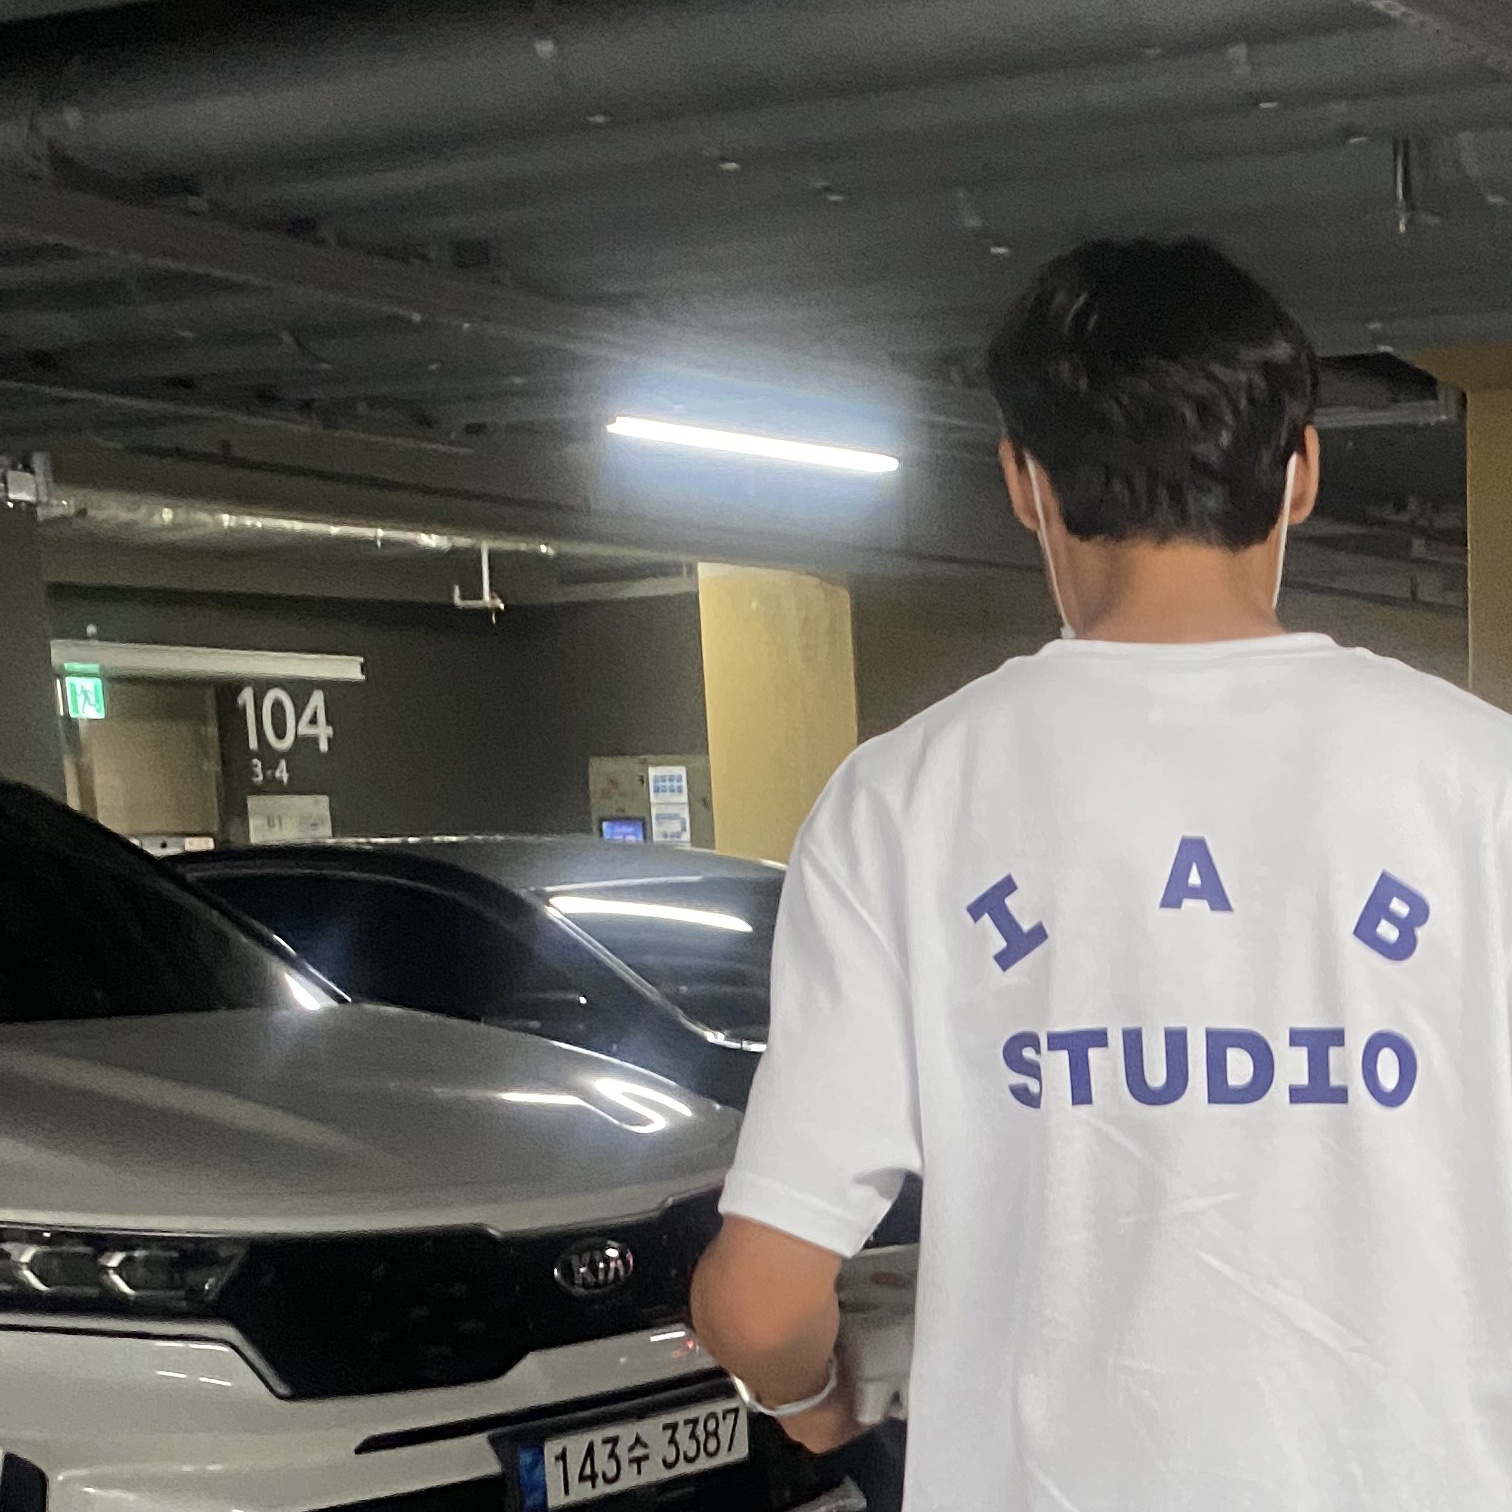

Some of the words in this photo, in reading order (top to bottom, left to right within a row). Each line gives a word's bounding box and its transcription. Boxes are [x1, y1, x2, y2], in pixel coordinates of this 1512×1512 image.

[236, 686, 334, 753] 104
[1002, 1026, 1418, 1108] STUDIO
[569, 1249, 628, 1289] KIA
[554, 1431, 651, 1497] 143수
[661, 1406, 741, 1470] 3387
